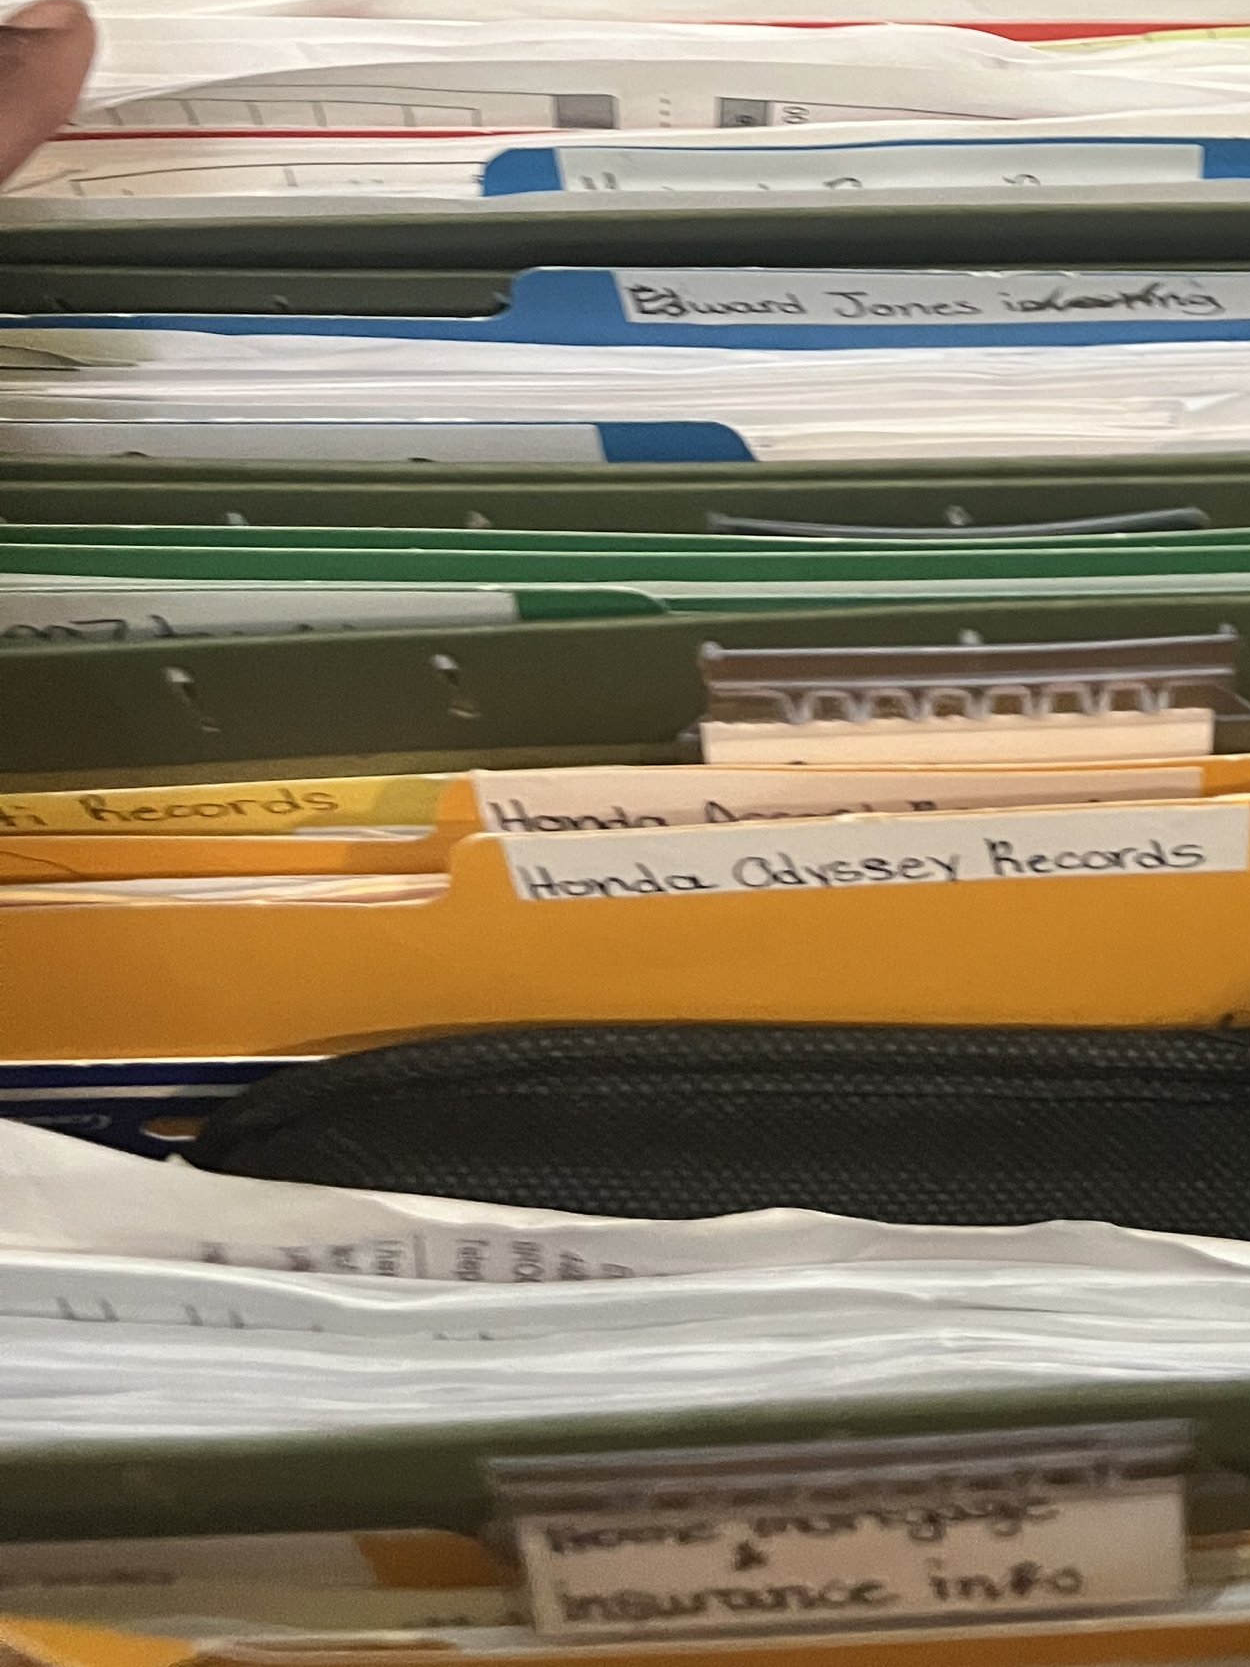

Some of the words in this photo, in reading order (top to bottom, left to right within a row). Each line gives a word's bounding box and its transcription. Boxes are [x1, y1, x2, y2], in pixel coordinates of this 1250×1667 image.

[630, 284, 808, 318] Edward
[824, 291, 982, 319] Jones
[78, 787, 341, 824] Records
[516, 864, 717, 899] Honda
[732, 850, 961, 891] Odyssey
[986, 836, 1207, 877] Records
[925, 1556, 1084, 1604] info
